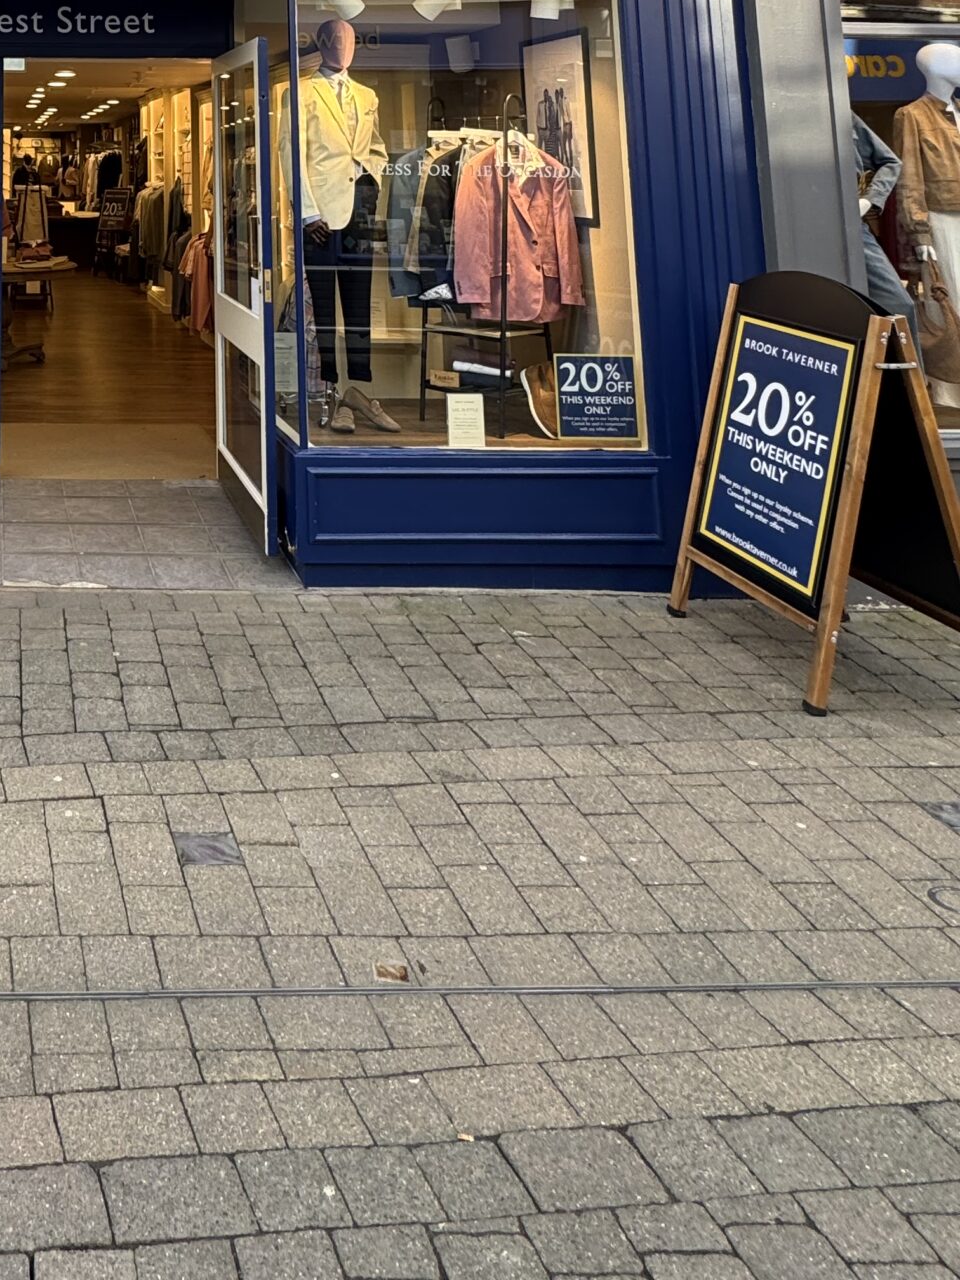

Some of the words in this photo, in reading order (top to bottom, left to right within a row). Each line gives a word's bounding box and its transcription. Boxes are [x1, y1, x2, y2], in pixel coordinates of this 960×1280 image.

[56, 6, 156, 34] Street
[744, 338, 779, 358] BROOK
[781, 349, 839, 376] TAVERNER
[559, 362, 620, 393] 20%
[605, 381, 633, 393] OFF
[560, 395, 583, 404] THIS
[584, 395, 635, 405] WEEKEND
[584, 406, 612, 415] ONLY
[730, 372, 815, 437] 20%
[788, 425, 829, 456] OFF
[727, 426, 754, 450] THIS
[755, 439, 824, 480] WEEKEND
[750, 457, 788, 484] ONLY
